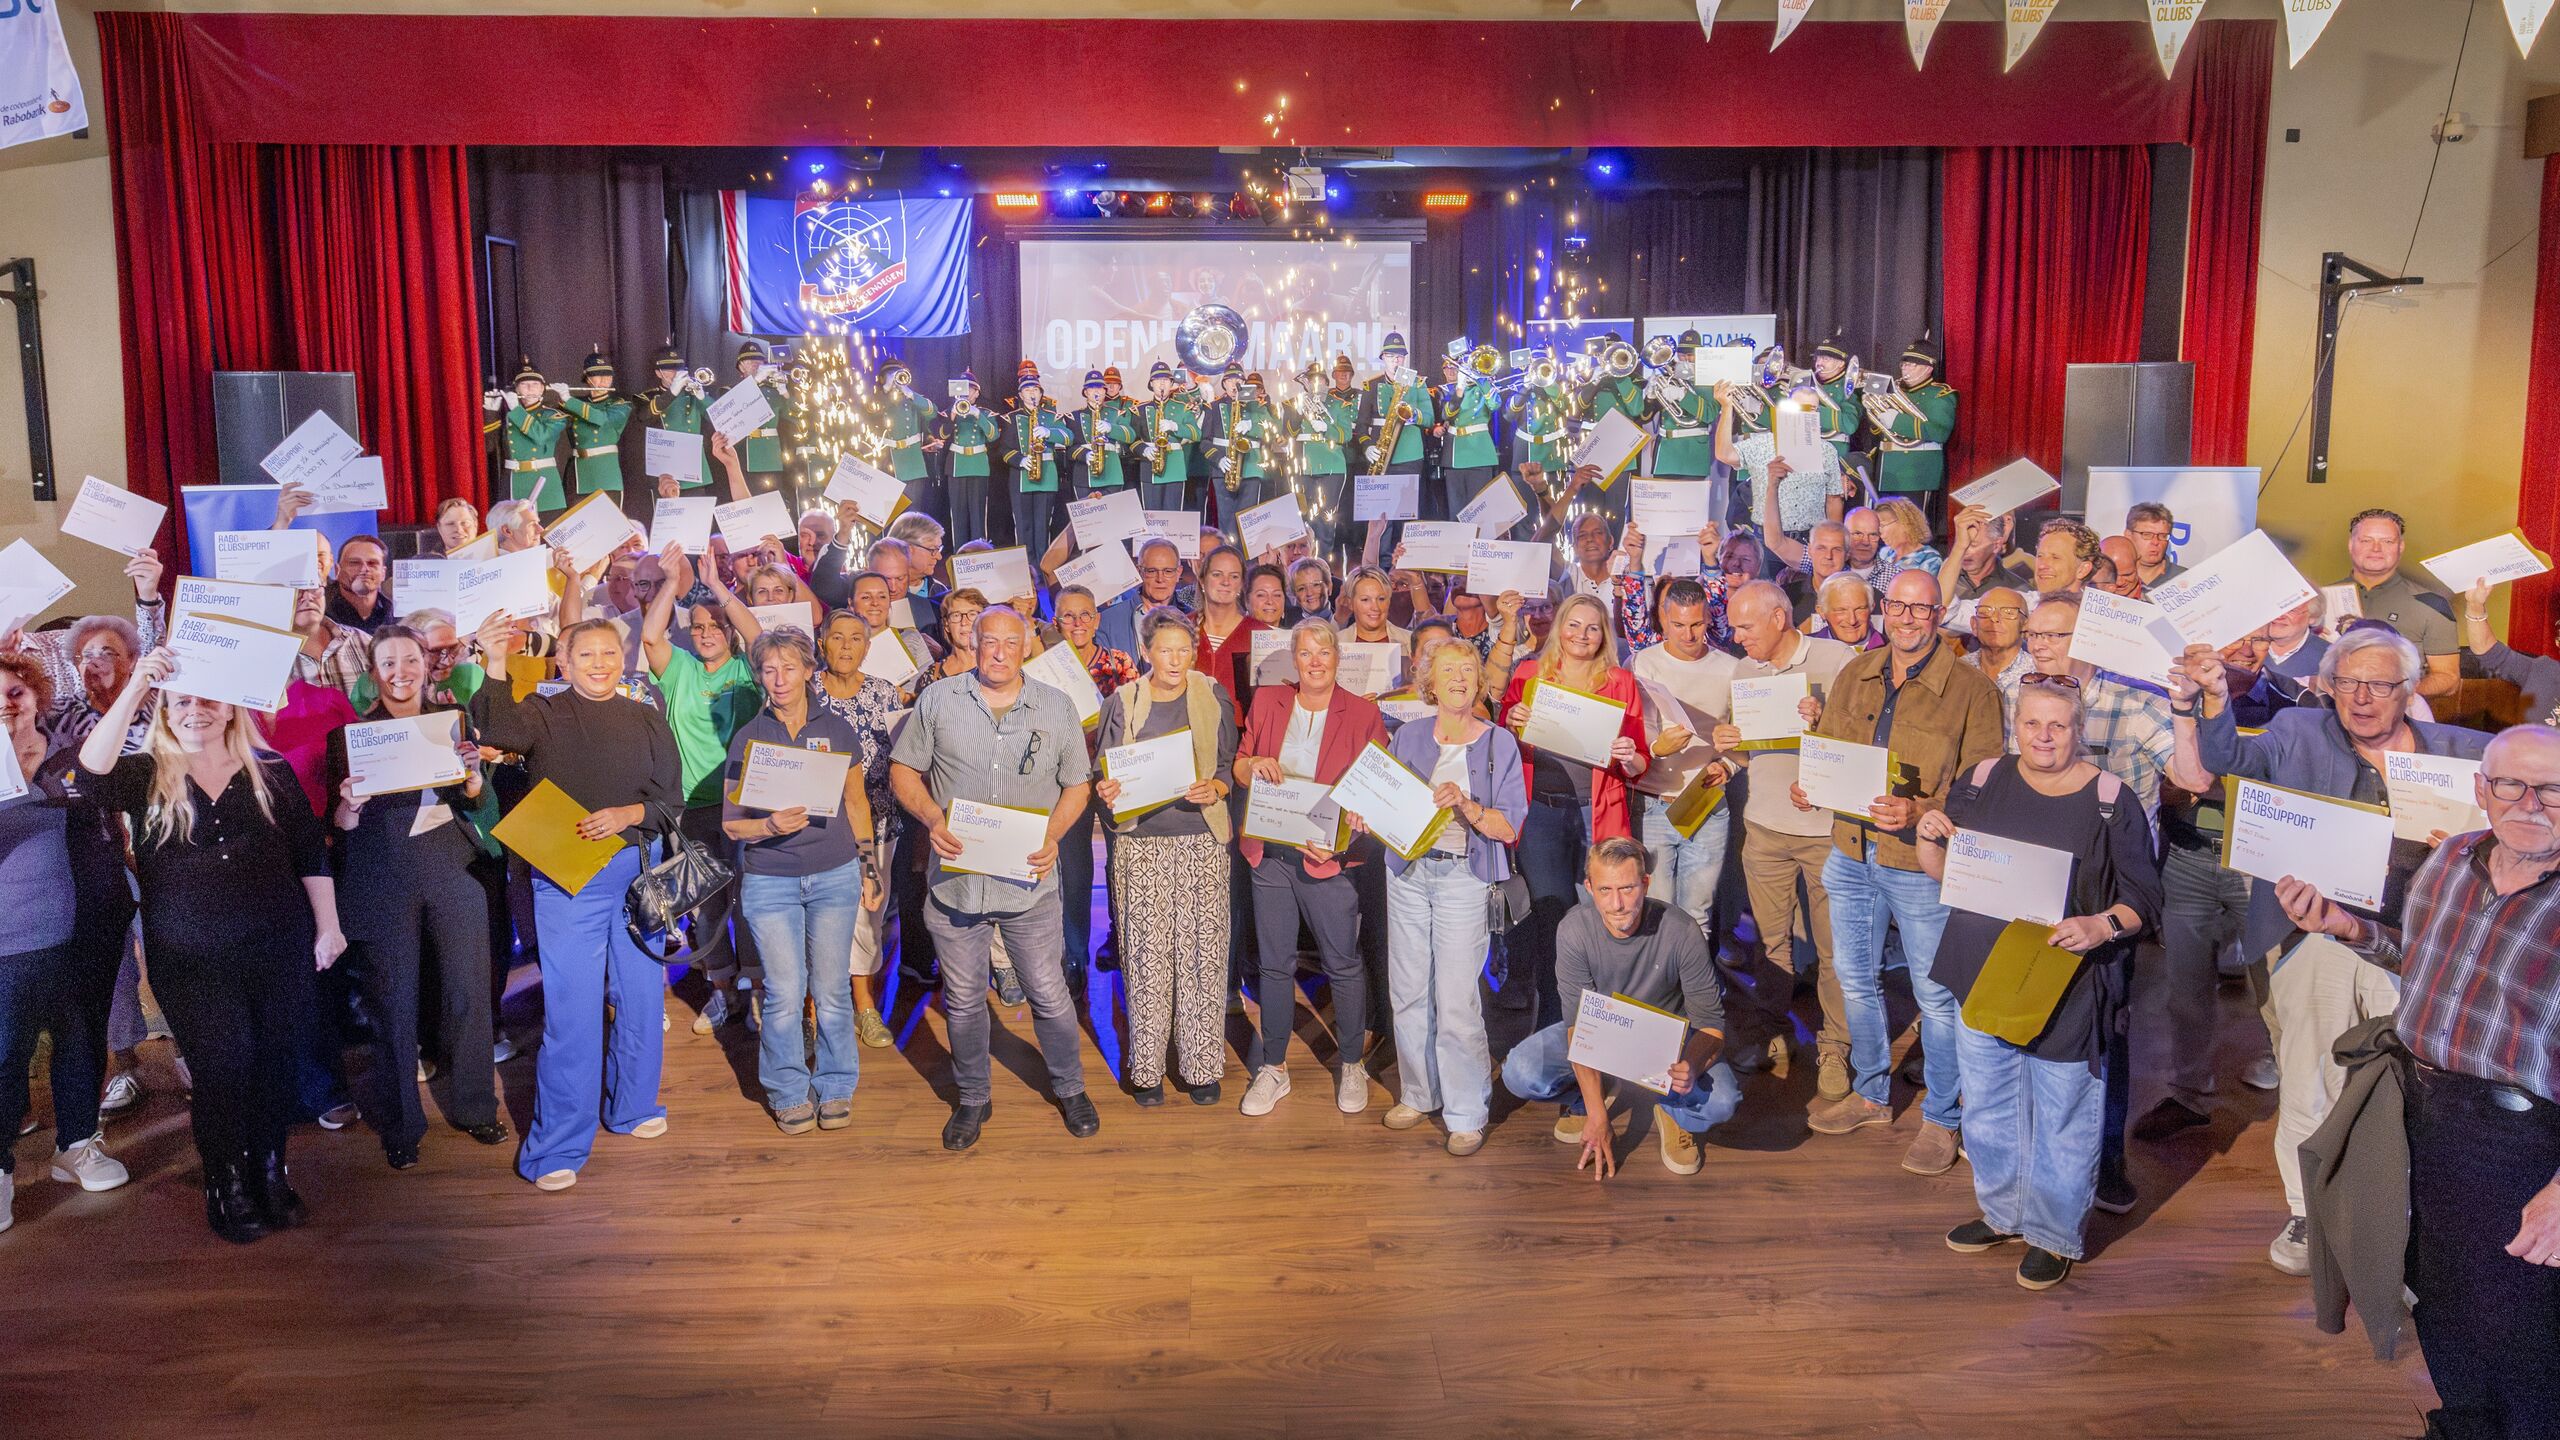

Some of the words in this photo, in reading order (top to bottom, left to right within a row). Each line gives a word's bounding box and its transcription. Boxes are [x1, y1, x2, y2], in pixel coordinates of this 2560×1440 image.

[1910, 7, 1938, 20] CLUBS
[2292, 0, 2332, 12] CLUBS
[2011, 9, 2044, 22] CLUBS
[2156, 7, 2192, 22] CLUBS
[2, 104, 46, 126] Rabobank
[840, 462, 873, 484] CLUBSUPPORT
[87, 479, 104, 492] RABO
[83, 488, 126, 510] CLUBSUPPORT
[718, 506, 753, 521] CLUBSUPPORT
[1070, 503, 1084, 511] RABO
[1072, 504, 1108, 518] CLUBSUPPORT
[218, 534, 239, 543] RABO
[1473, 542, 1489, 550] RABO
[218, 542, 270, 552] CLUBSUPPORT
[956, 558, 970, 566] RABO
[1472, 550, 1514, 560] CLUBSUPPORT
[396, 570, 440, 579] CLUBSUPPORT
[459, 568, 476, 582] RABO
[957, 562, 994, 574] CLUBSUPPORT
[1061, 561, 1096, 584] CLUBSUPPORT
[458, 568, 502, 592] CLUBSUPPORT
[182, 584, 206, 594] RABO
[2154, 584, 2180, 603] RABO
[2161, 574, 2223, 613] CLUBSUPPORT
[181, 593, 240, 606] CLUBSUPPORT
[2087, 592, 2111, 606] RABO
[2085, 602, 2144, 626] CLUBSUPPORT
[181, 619, 206, 632] RABO
[176, 629, 240, 650] CLUBSUPPORT
[1536, 695, 1582, 716] CLUBSUPPORT
[350, 727, 374, 739] RABO
[351, 732, 409, 749] CLUBSUPPORT
[1802, 738, 1820, 749] RABO
[754, 746, 775, 758] RABO
[1109, 749, 1128, 761] RABO
[1801, 748, 1845, 765] CLUBSUPPORT
[752, 756, 804, 771] CLUBSUPPORT
[1110, 752, 1155, 770] CLUBSUPPORT
[2389, 756, 2412, 769] RABO
[1360, 755, 1403, 791] CLUBSUPPORT
[1254, 785, 1300, 800] CLUBSUPPORT
[2242, 786, 2271, 805] RABO
[955, 802, 974, 814] RABO
[2241, 799, 2316, 830] CLUBSUPPORT
[952, 812, 1002, 830] CLUBSUPPORT
[1953, 832, 1977, 847] RABO
[1951, 842, 2012, 865] CLUBSUPPORT
[1584, 994, 1606, 1009] RABO
[1582, 1006, 1634, 1030] CLUBSUPPORT
